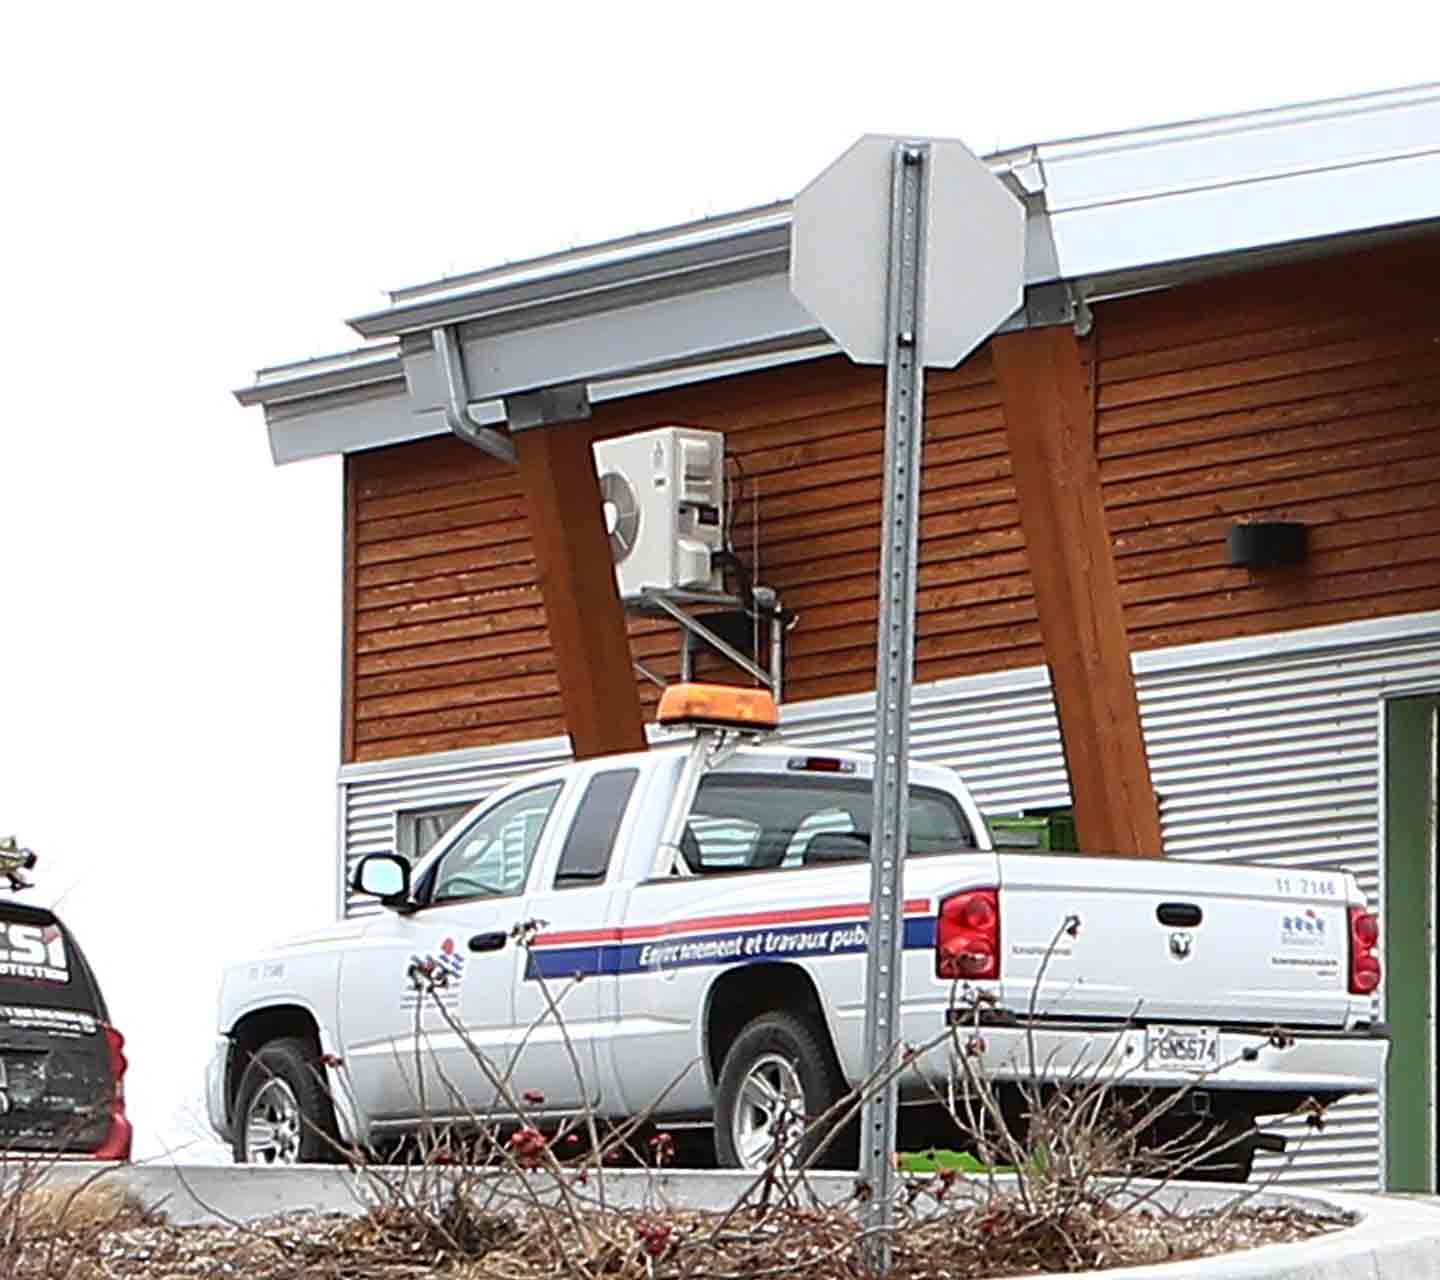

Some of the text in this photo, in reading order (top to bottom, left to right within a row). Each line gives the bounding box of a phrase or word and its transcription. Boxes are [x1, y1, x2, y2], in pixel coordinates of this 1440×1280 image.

[744, 934, 761, 955] et
[765, 931, 827, 953] travaux
[830, 924, 870, 951] pub
